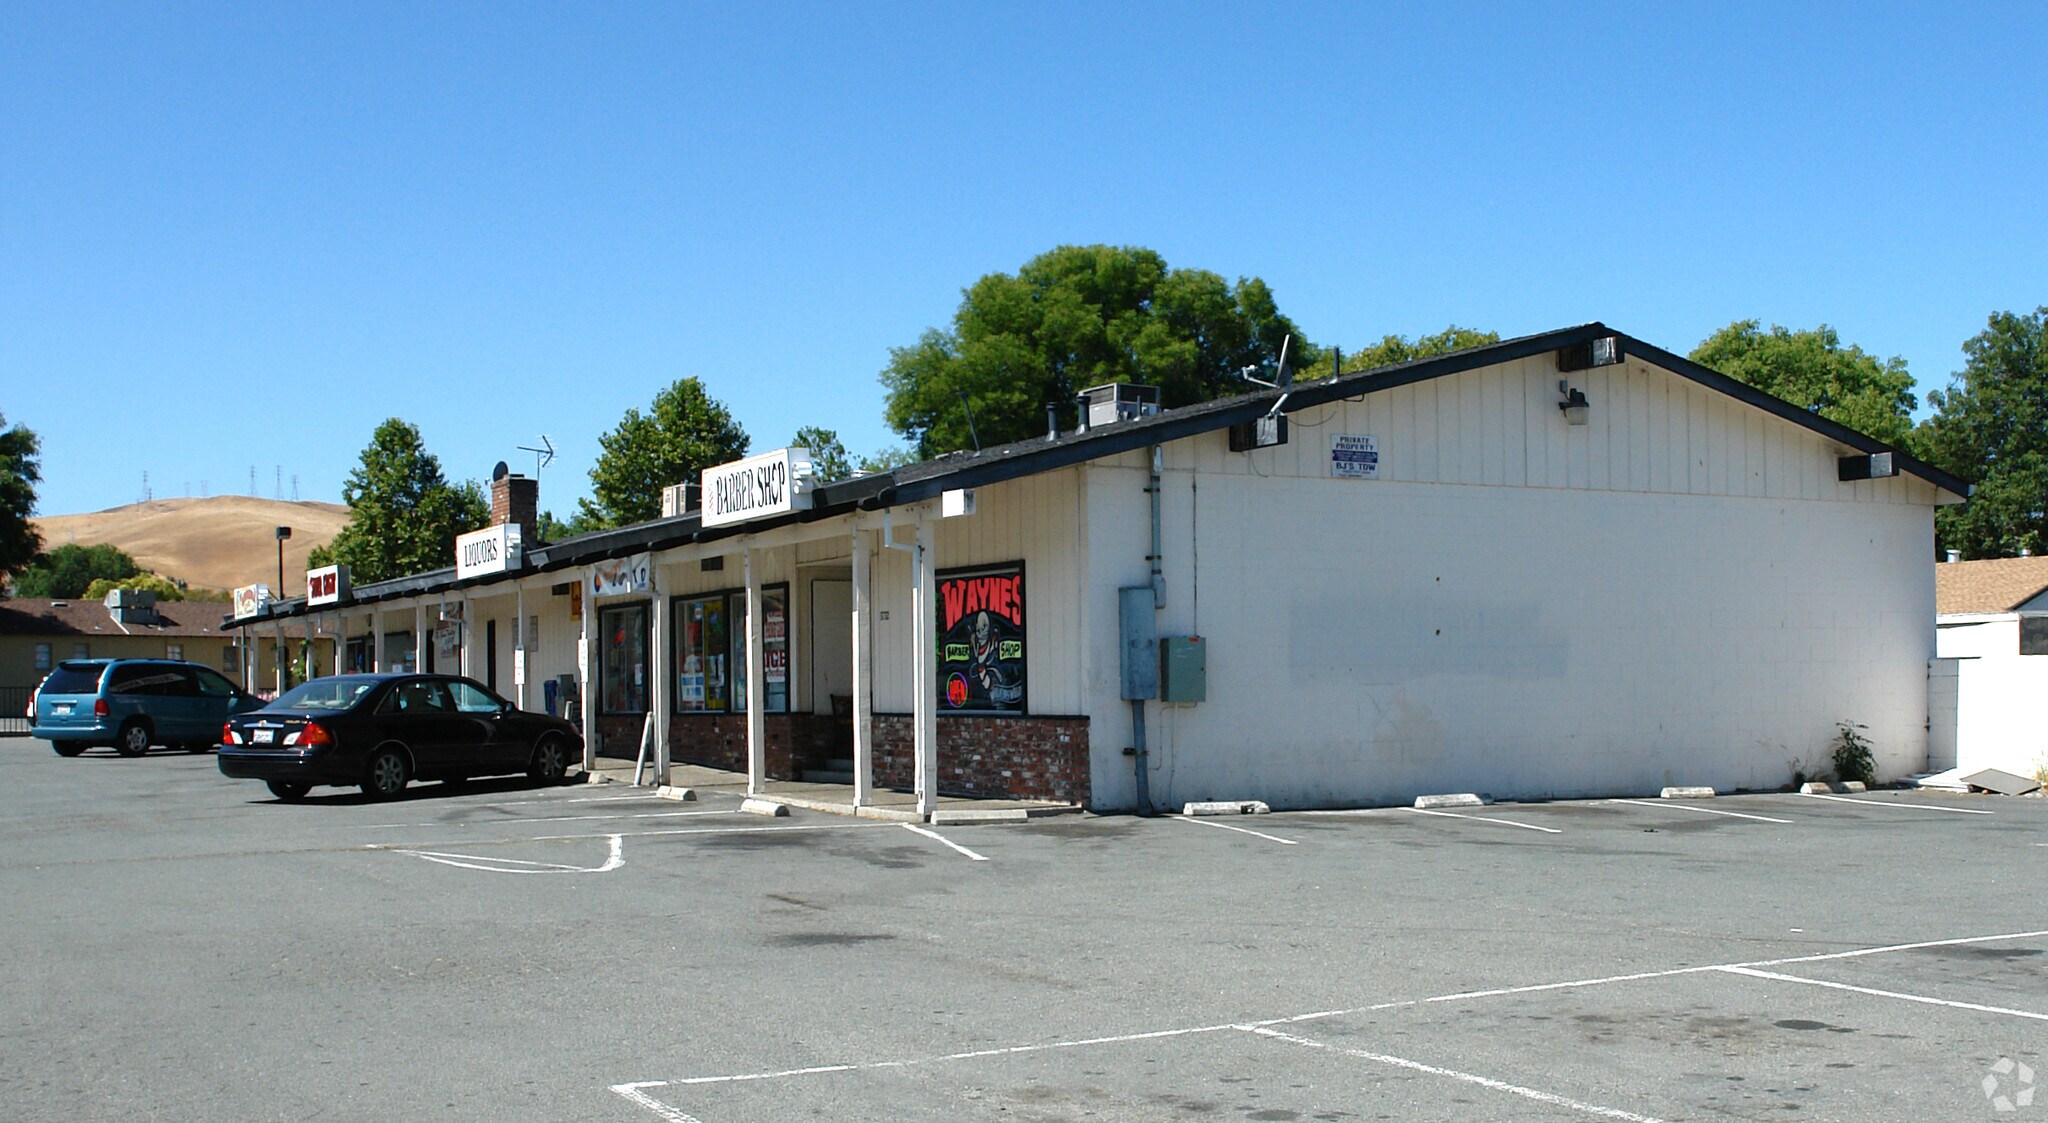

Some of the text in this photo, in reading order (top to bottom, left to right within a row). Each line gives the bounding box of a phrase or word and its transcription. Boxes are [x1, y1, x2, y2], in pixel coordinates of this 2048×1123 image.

[1336, 443, 1374, 451] PROPERTY
[1340, 436, 1369, 444] PRIVATE
[1358, 463, 1376, 471] TOW
[716, 460, 786, 515] BARBER SHOP
[464, 538, 498, 567] LIQUORS
[941, 575, 1022, 631] WAYNES
[947, 642, 1021, 659] BARBER SHOP
